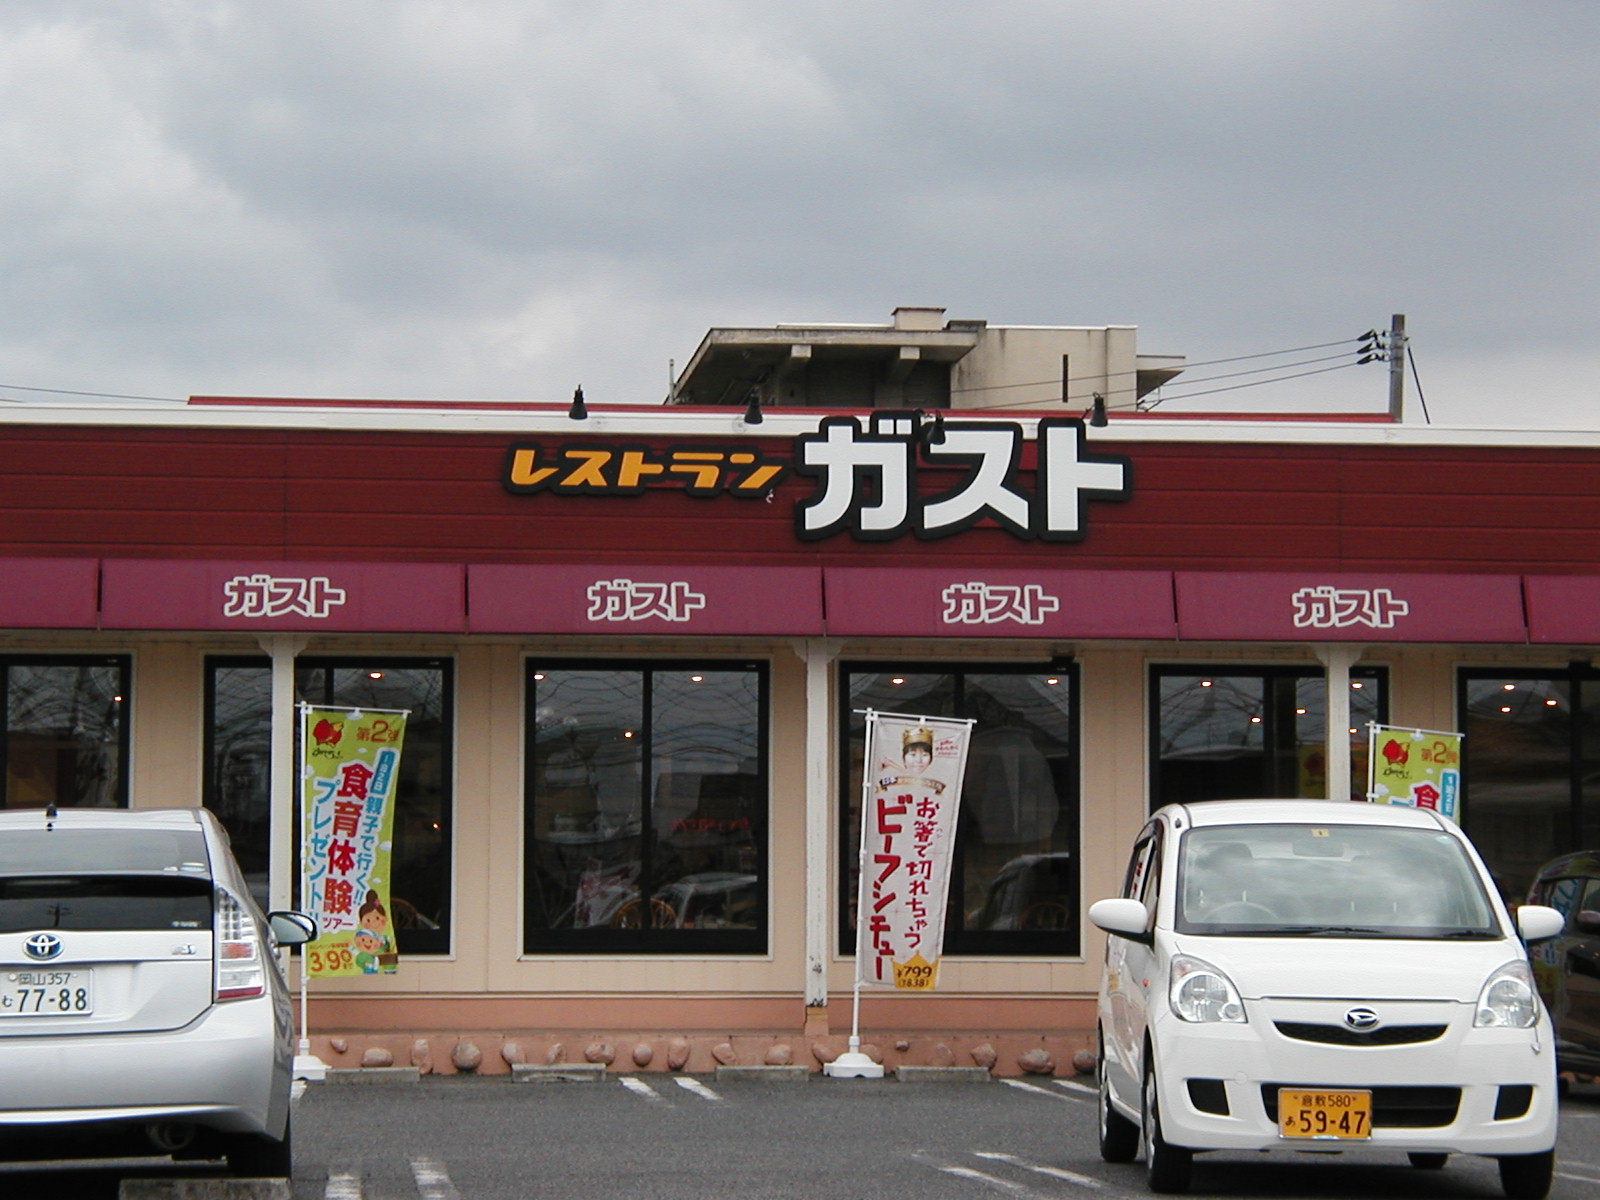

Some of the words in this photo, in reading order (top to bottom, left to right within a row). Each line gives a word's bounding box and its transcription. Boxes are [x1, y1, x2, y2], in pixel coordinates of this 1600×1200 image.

[511, 449, 784, 489] レストラン
[804, 418, 1125, 532] ガスト
[223, 575, 346, 617] ガスト
[587, 580, 706, 622] ガスト
[942, 583, 1060, 625] ガスト
[1292, 587, 1409, 629] ガスト
[356, 720, 400, 743] 第2弾
[322, 763, 374, 915] 食育体験
[869, 794, 914, 981] ビーフシチュー
[904, 796, 941, 949] お箸で切れちゃう
[322, 916, 354, 930] ツアー
[897, 965, 933, 978] ¥799
[16, 987, 88, 1012] 77-88
[1299, 1109, 1367, 1134] 59-47
[1302, 1095, 1352, 1107] 倉敷580
